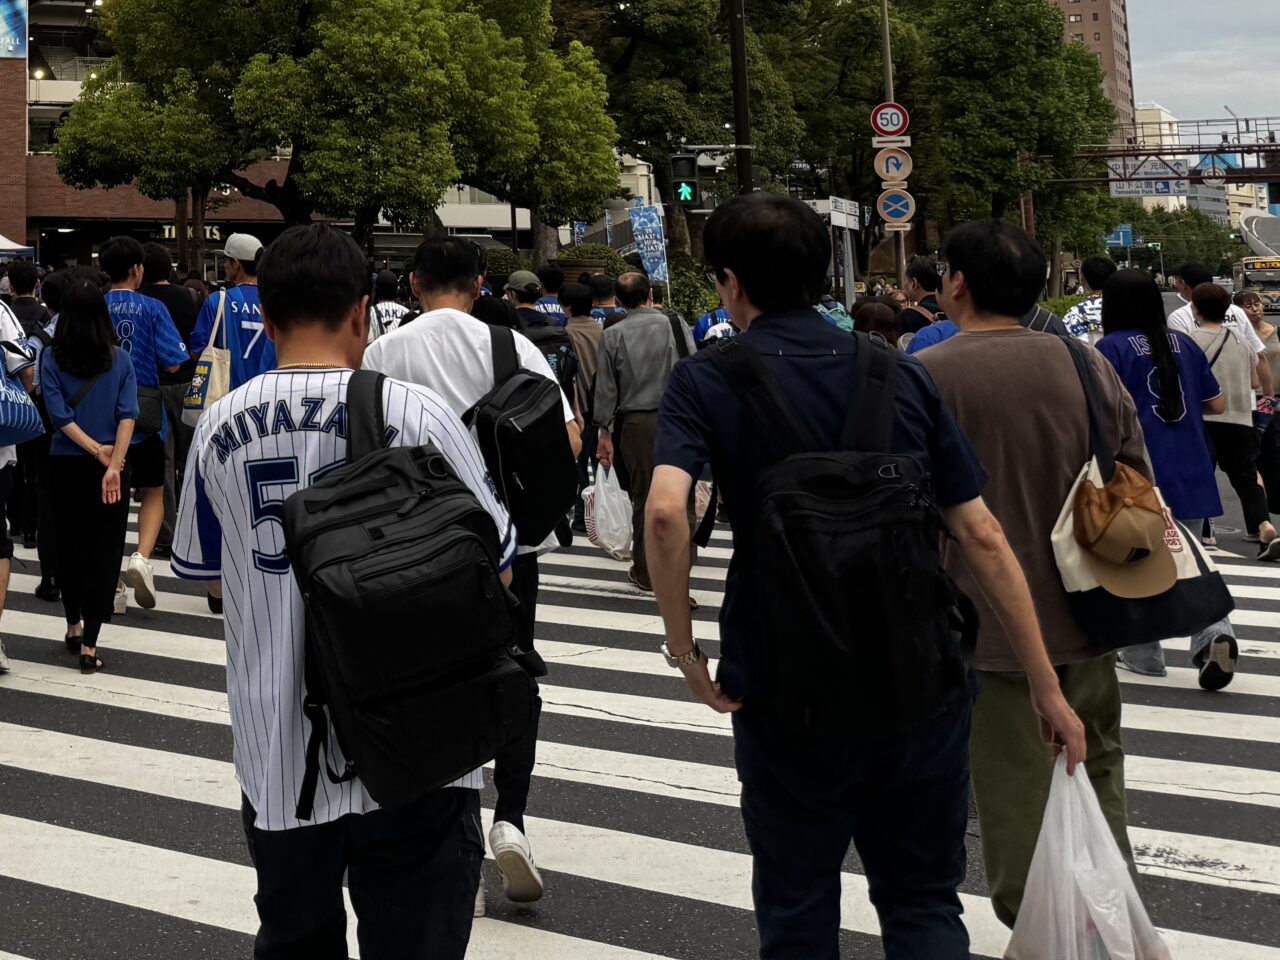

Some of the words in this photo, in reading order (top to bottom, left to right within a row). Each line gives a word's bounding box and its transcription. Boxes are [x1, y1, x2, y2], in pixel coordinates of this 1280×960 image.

[879, 112, 901, 128] 50
[162, 224, 220, 240] TIKTS
[231, 300, 262, 316] SAN
[241, 320, 265, 360] 7
[1127, 333, 1181, 357] ISII
[209, 397, 400, 465] MIYAZAI
